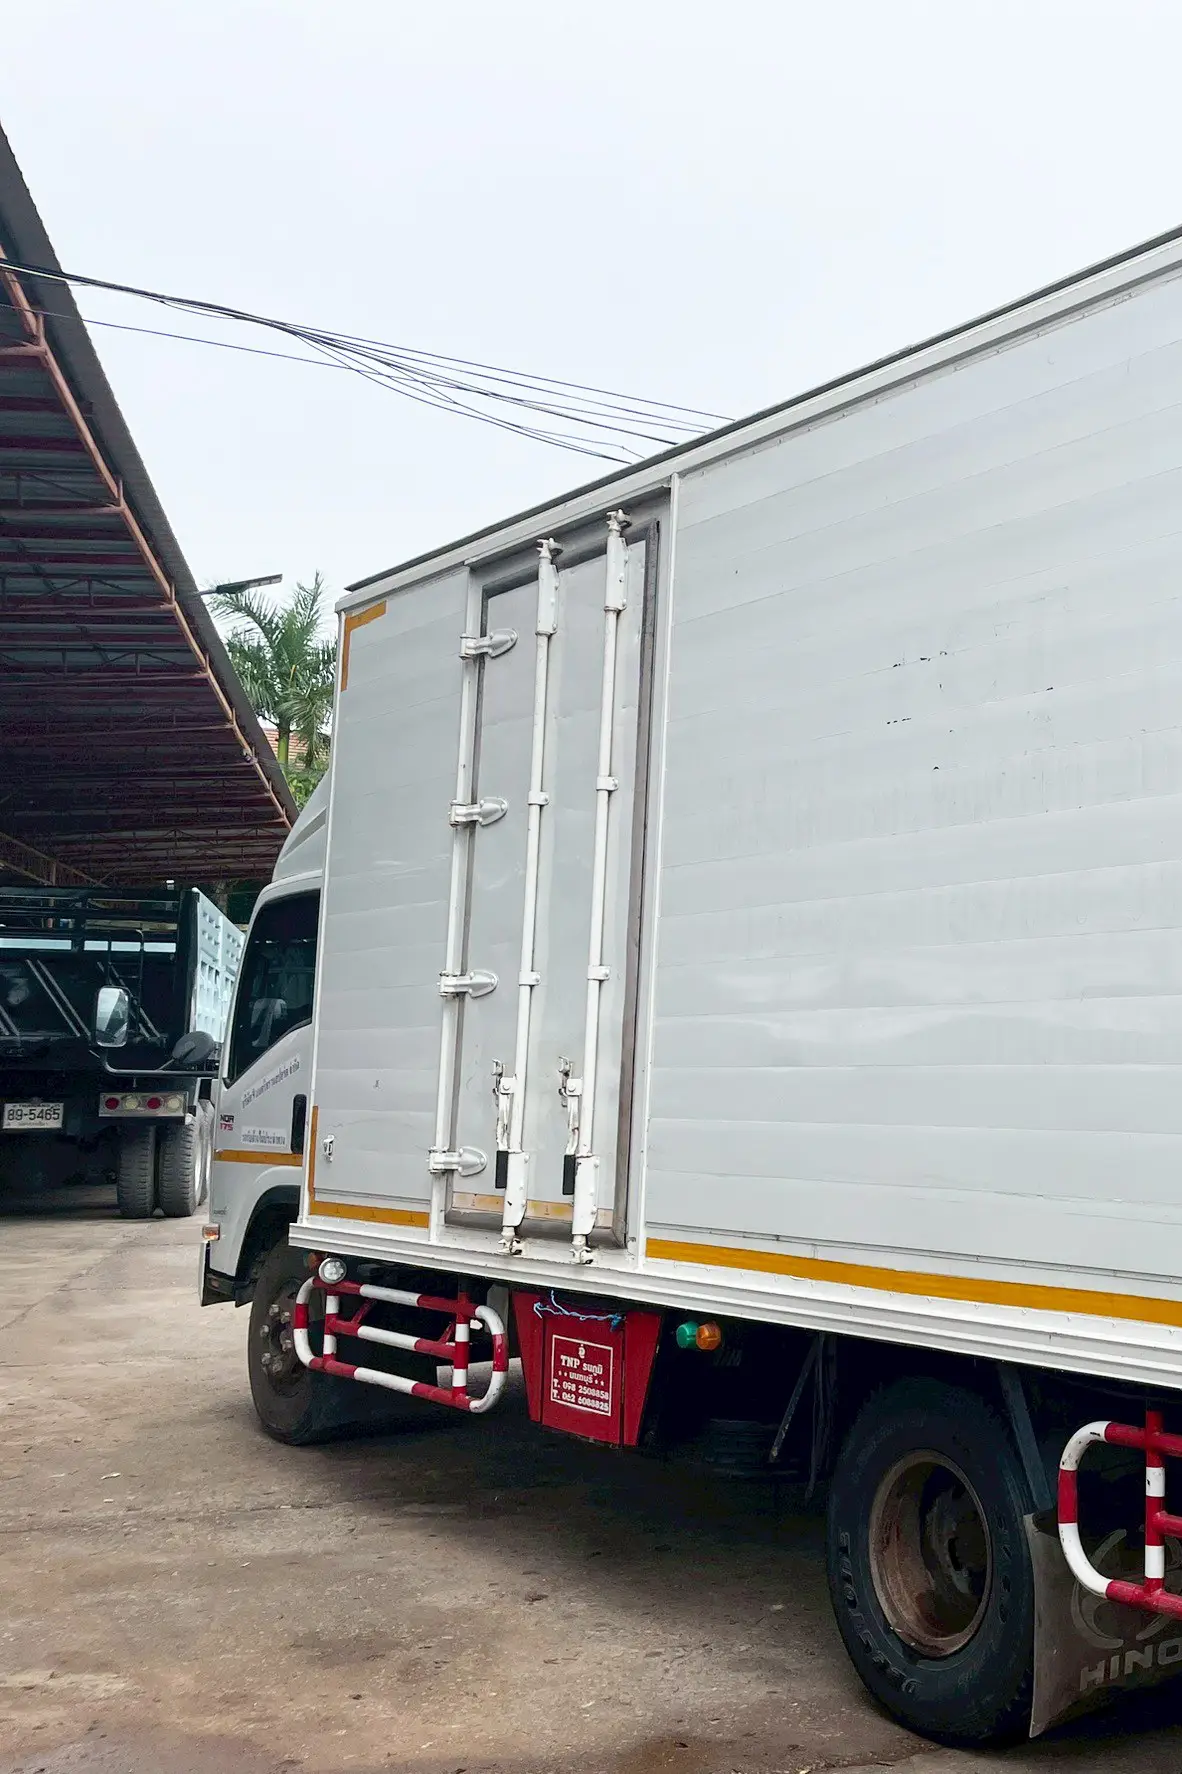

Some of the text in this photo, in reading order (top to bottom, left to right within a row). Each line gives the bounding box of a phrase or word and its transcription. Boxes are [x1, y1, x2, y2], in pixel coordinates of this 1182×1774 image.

[8, 1108, 60, 1121] 89-5465
[220, 1122, 233, 1131] 175
[560, 1354, 580, 1369] TNP
